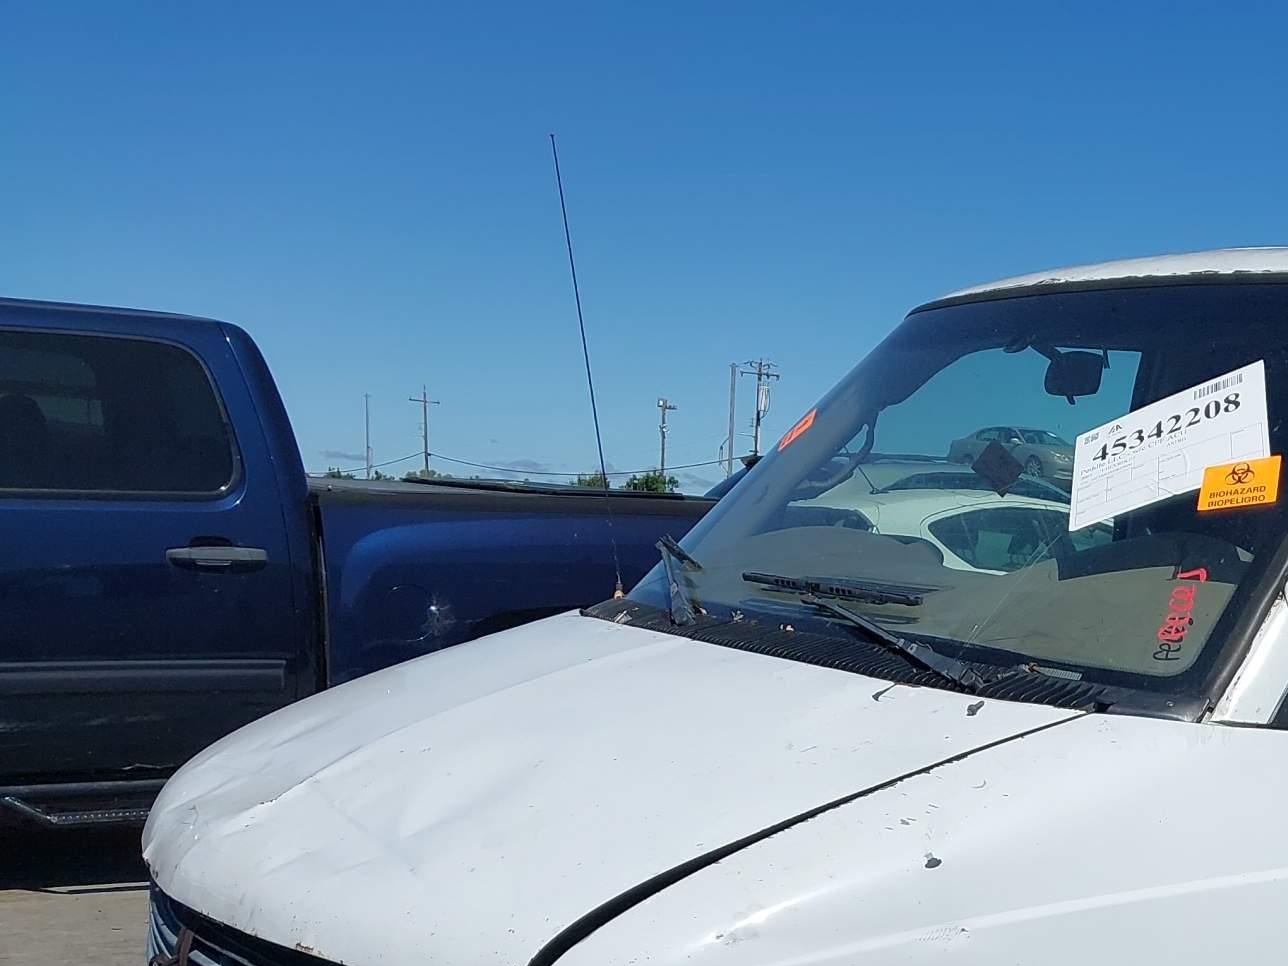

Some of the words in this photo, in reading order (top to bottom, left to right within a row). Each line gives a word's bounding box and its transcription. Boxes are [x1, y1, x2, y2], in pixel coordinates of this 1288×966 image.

[1092, 392, 1241, 462] 45342208
[1209, 485, 1267, 499] BIOHAZARD
[1207, 494, 1266, 508] BIOPELIGRO
